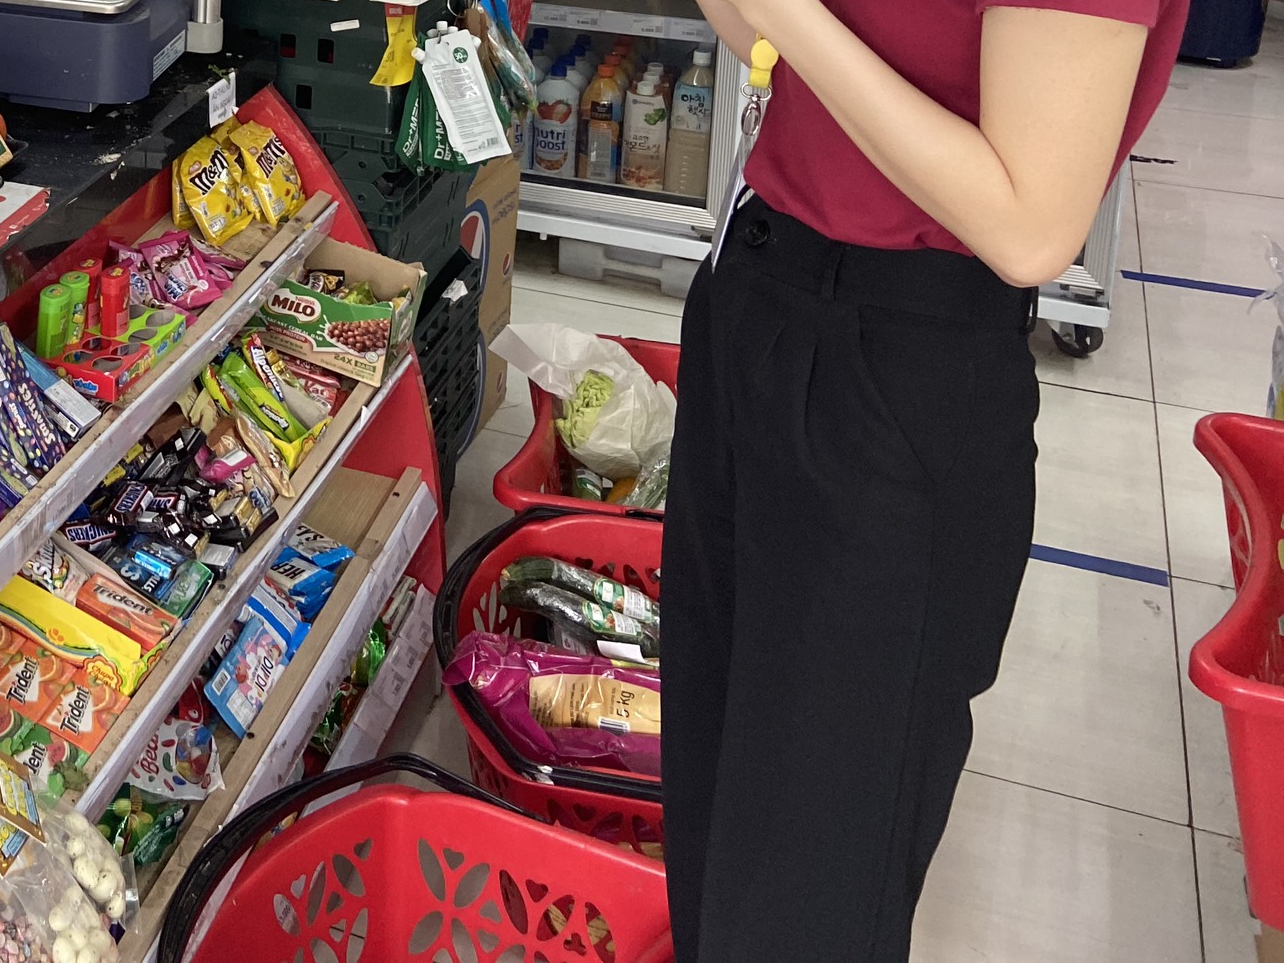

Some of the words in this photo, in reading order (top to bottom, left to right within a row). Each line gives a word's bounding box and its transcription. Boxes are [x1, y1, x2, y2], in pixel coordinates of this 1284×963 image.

[271, 294, 315, 317] MILO
[91, 583, 154, 616] Trident
[6, 656, 39, 705] Trident
[60, 686, 93, 735] Trident
[617, 690, 635, 705] kg
